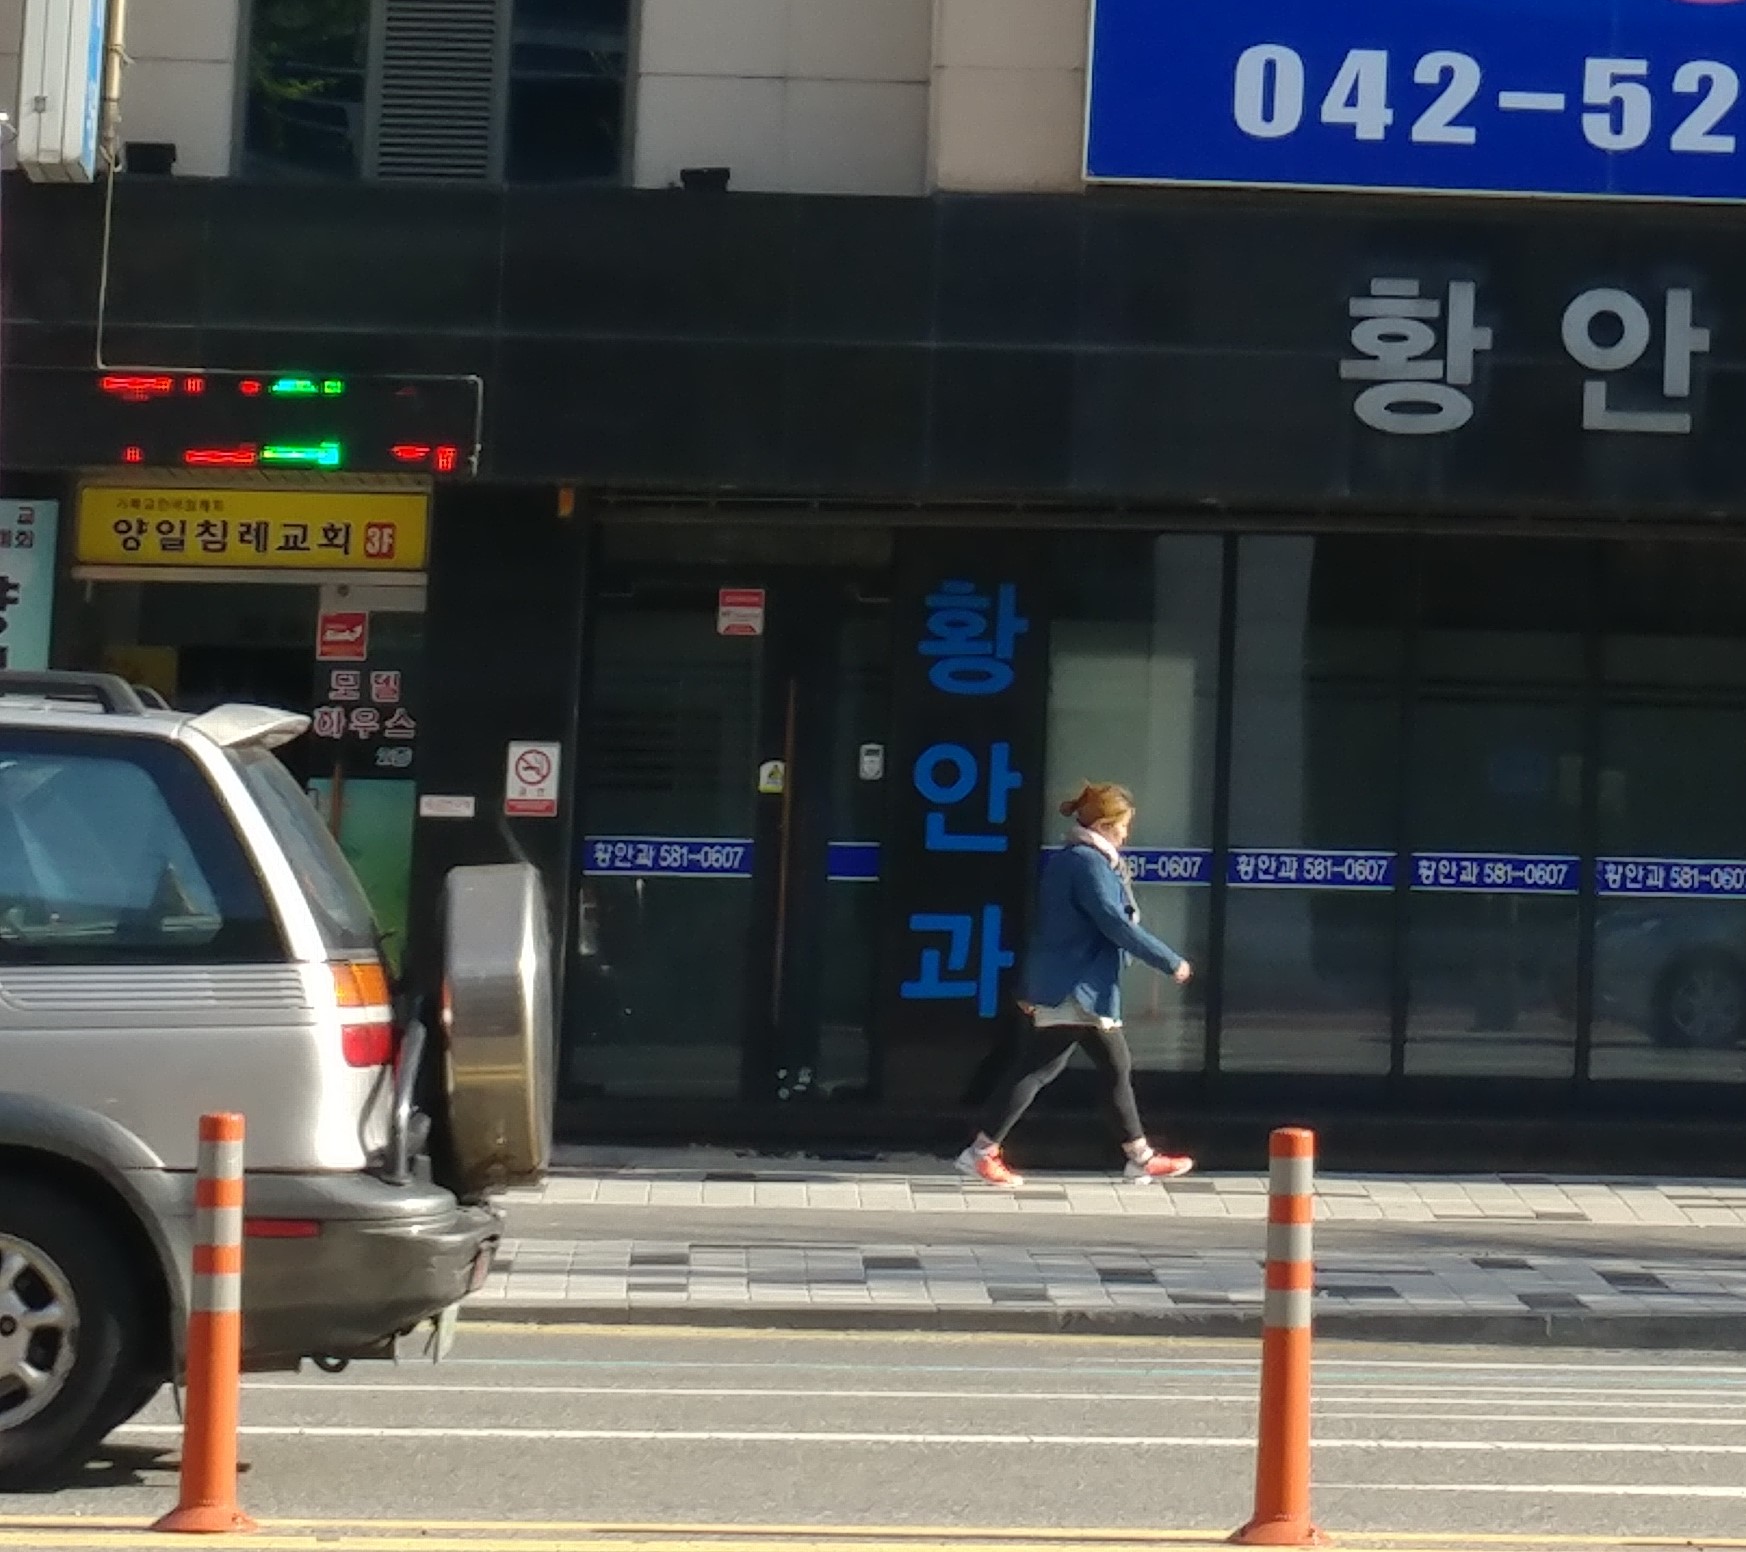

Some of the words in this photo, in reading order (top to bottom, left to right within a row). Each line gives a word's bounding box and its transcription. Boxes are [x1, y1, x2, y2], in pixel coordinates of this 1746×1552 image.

[365, 526, 394, 556] 3F
[312, 706, 416, 740] 하우스
[901, 579, 1029, 1018] 황안과
[593, 842, 655, 868] 황안과
[659, 844, 744, 870] 581-0607
[1117, 855, 1203, 880] 81-0607
[1236, 853, 1298, 879] 황안과
[1303, 855, 1388, 882] 581-0607
[1418, 858, 1478, 884] 황안과
[1483, 860, 1568, 886] 581-0607
[1605, 863, 1664, 889] 황안과
